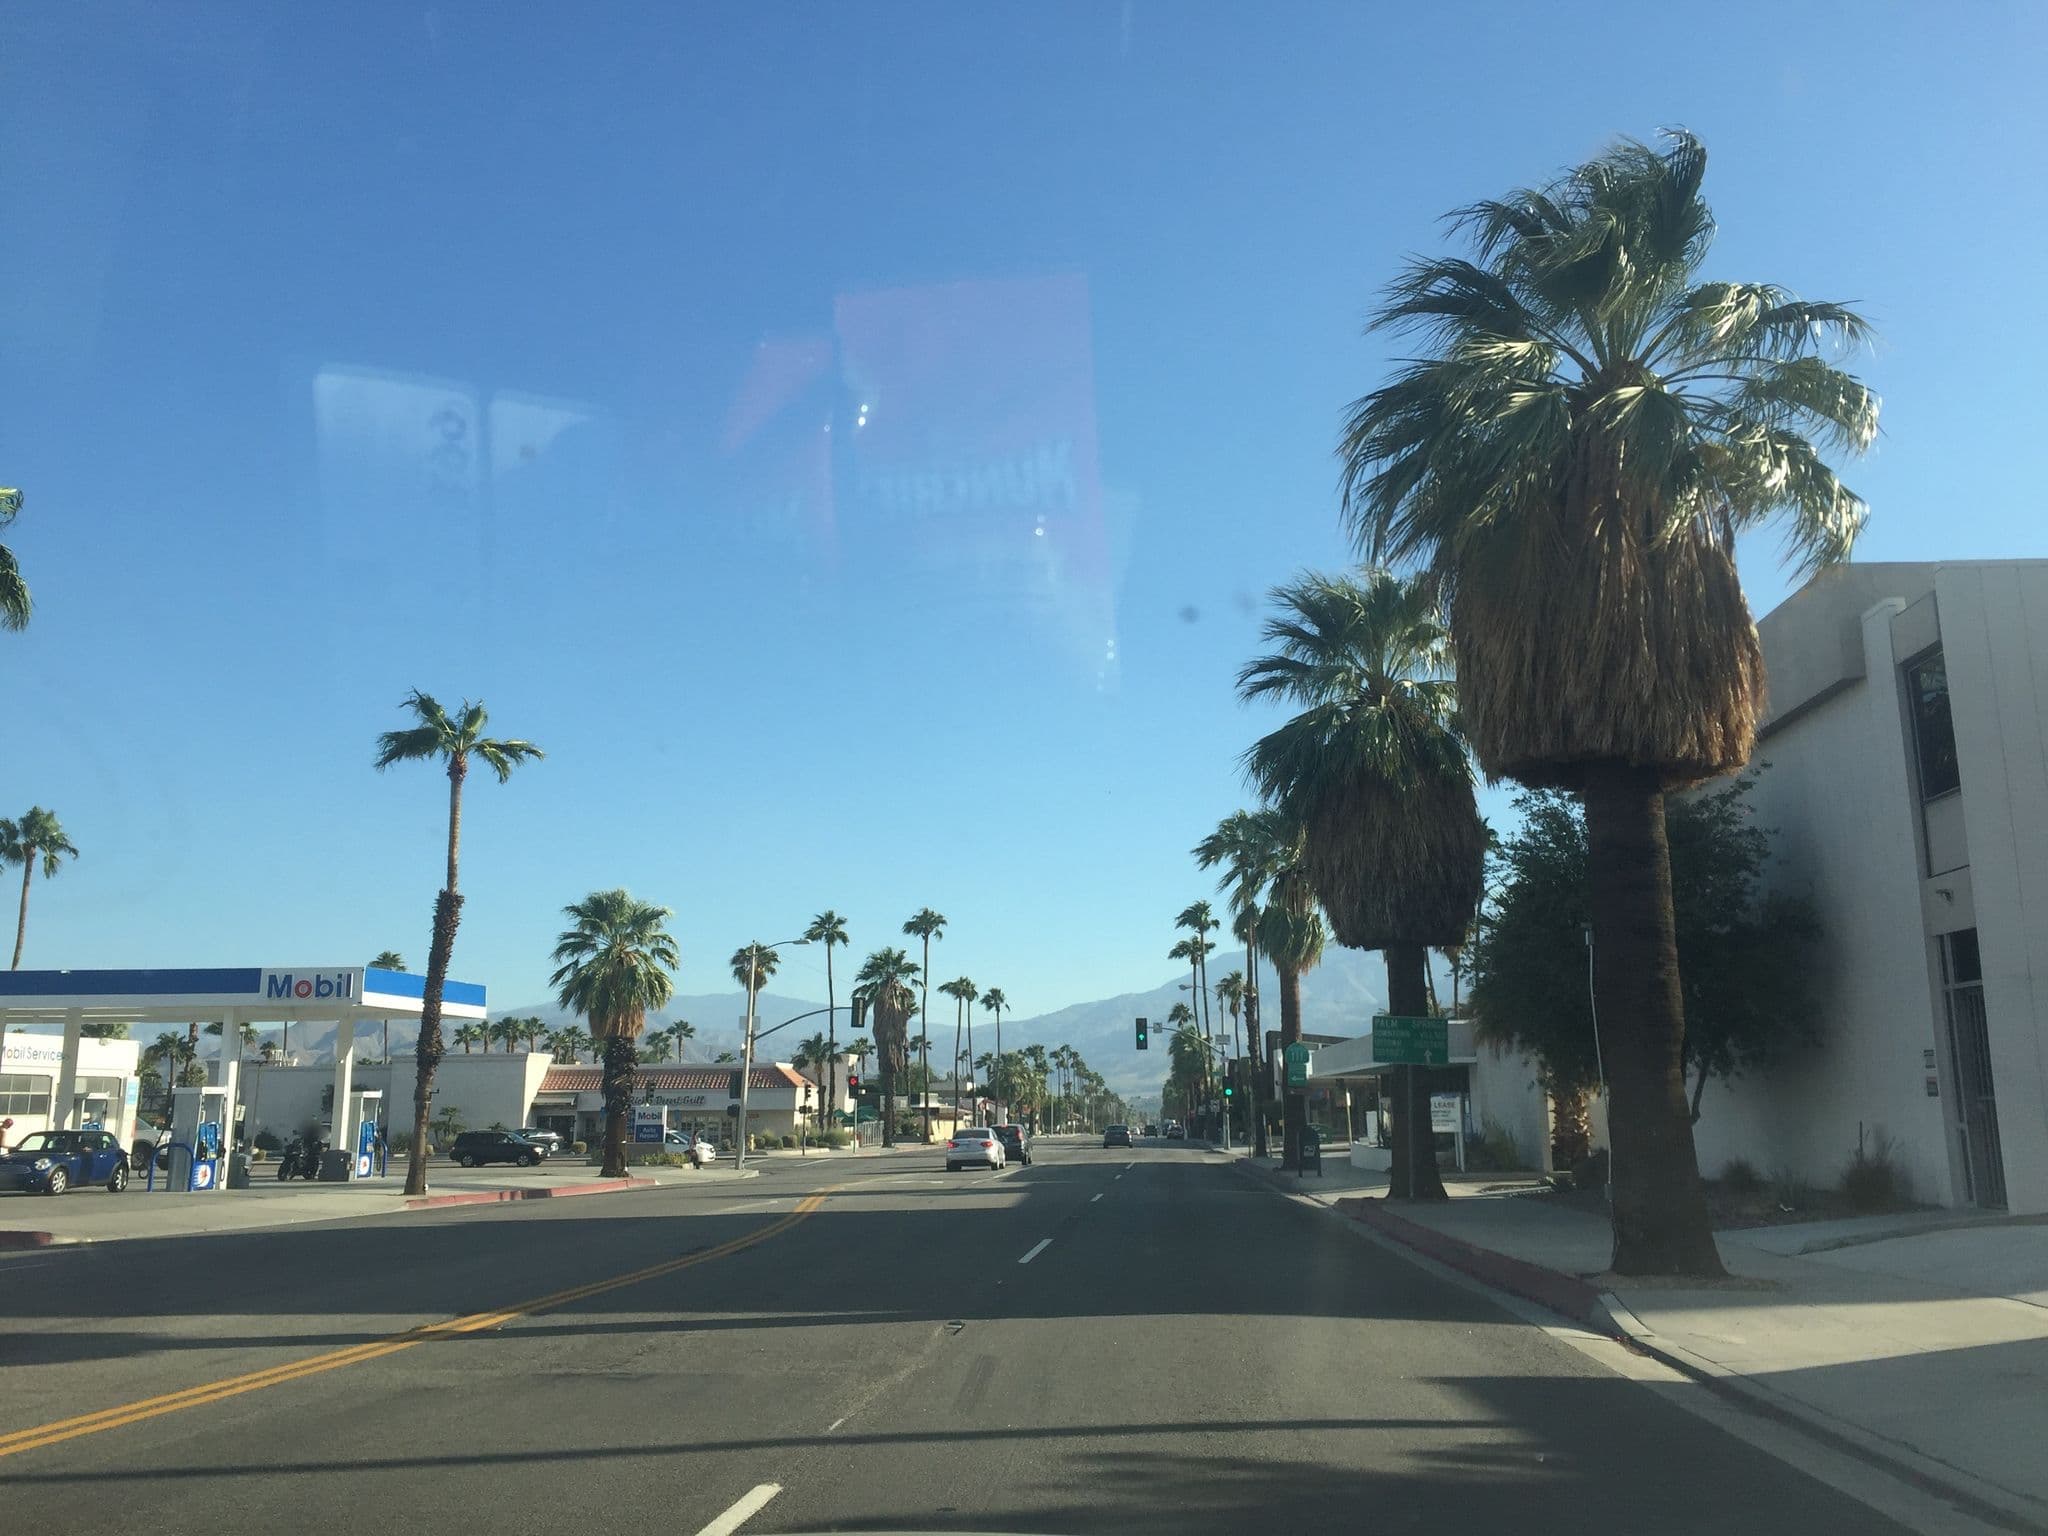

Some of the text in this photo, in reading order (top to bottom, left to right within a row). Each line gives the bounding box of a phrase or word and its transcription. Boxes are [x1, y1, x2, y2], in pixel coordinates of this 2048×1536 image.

[267, 973, 352, 999] Mobil
[1375, 1018, 1398, 1028] PALM
[1434, 1101, 1456, 1109] LEASE
[638, 1112, 662, 1120] Mobil
